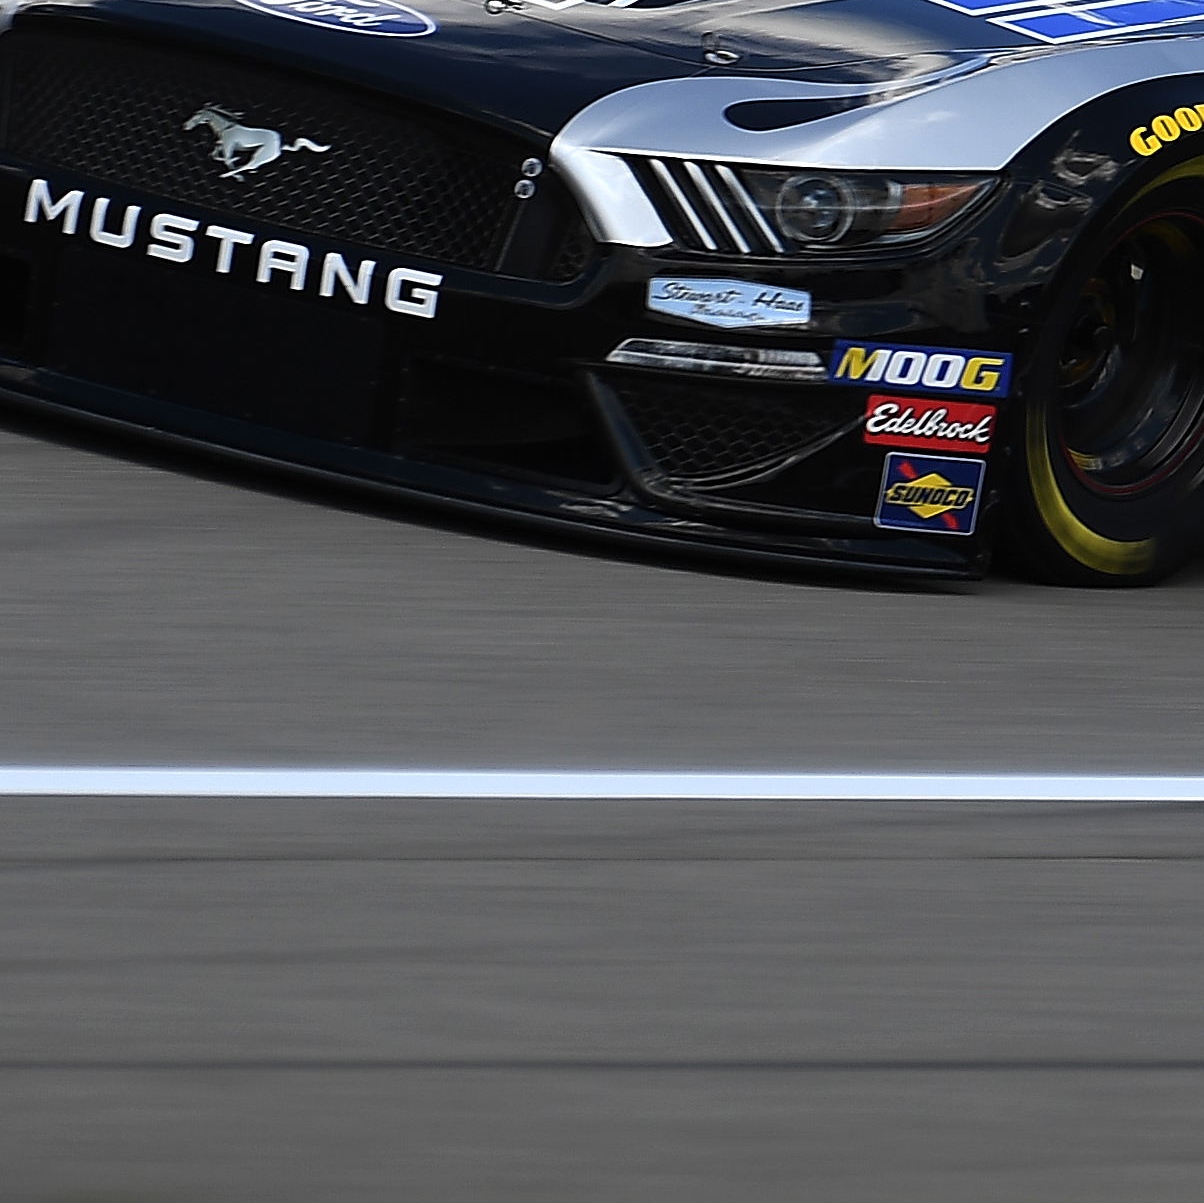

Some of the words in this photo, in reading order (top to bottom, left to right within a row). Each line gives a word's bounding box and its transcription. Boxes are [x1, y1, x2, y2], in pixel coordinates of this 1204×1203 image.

[23, 178, 443, 319] MUSTANG
[834, 346, 1006, 393] MOOG
[864, 402, 993, 445] Edelbrock
[888, 483, 973, 510] SUNOCO
